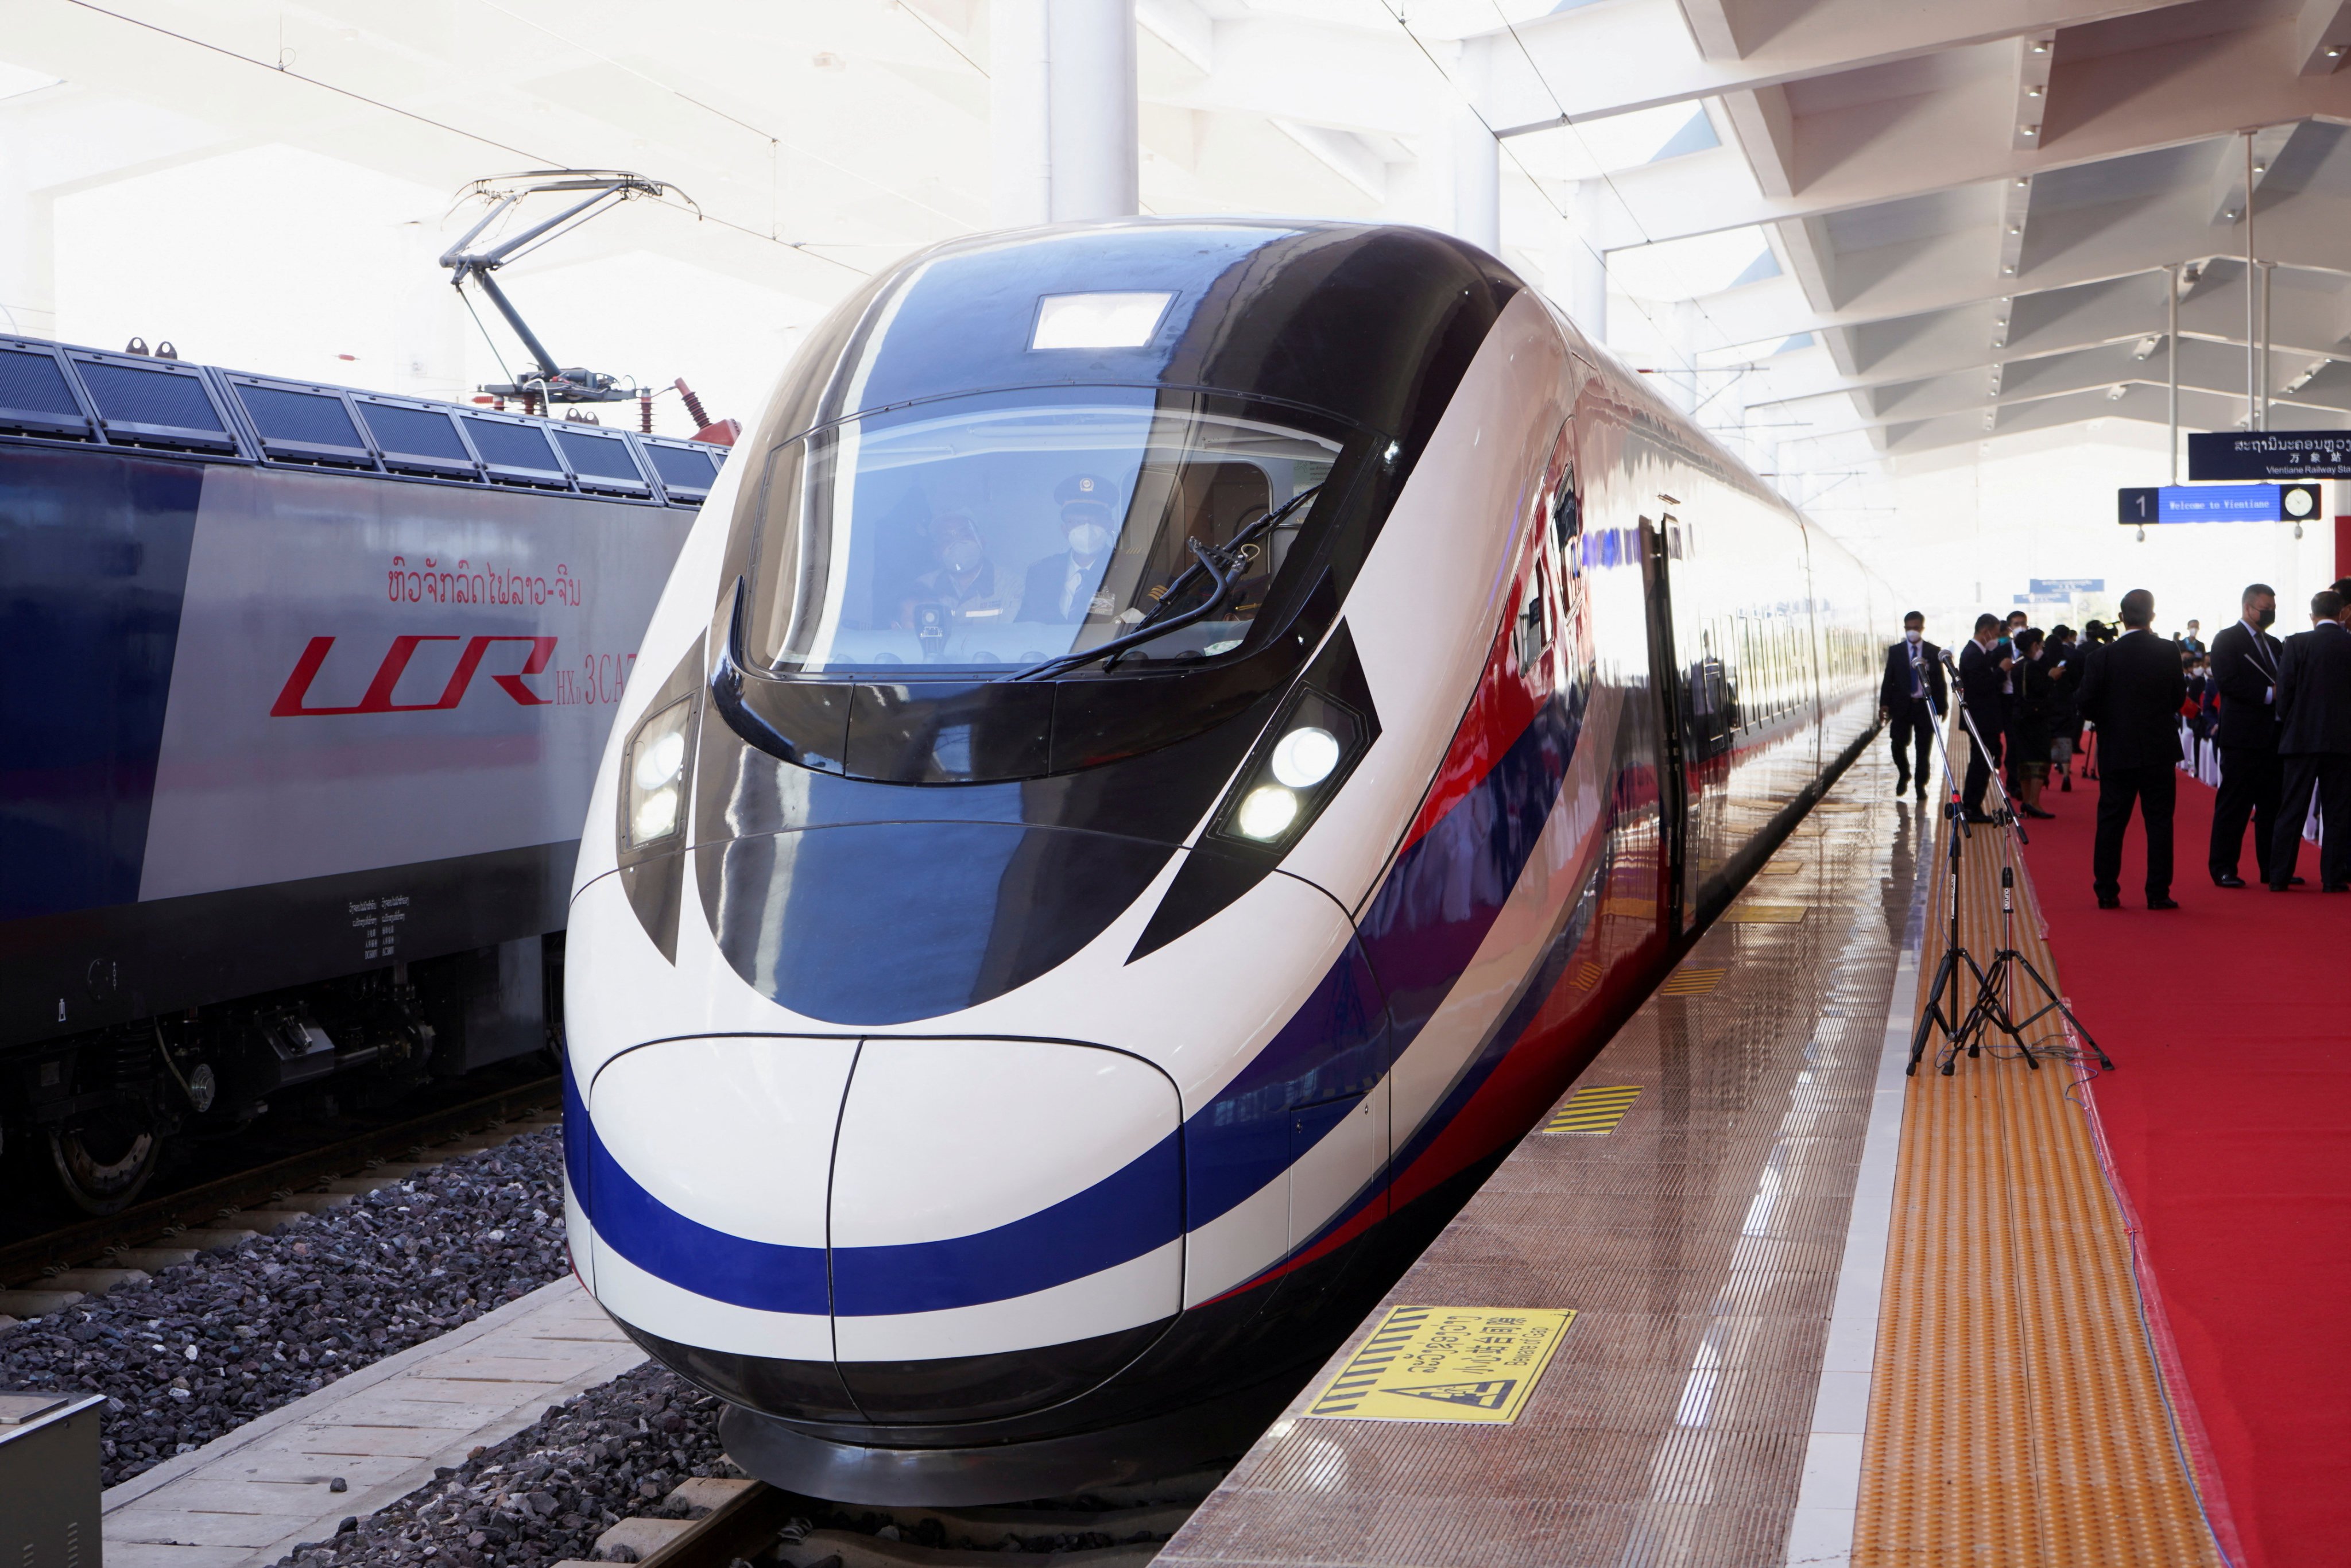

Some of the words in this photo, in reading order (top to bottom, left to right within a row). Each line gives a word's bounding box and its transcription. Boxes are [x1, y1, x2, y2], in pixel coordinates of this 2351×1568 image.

[2266, 466, 2304, 474] Vientiane
[2304, 464, 2337, 475] Railway
[2136, 495, 2145, 517] 1
[2170, 501, 2205, 510] Welcome
[2210, 501, 2221, 510] to
[2224, 499, 2269, 509] Vientiane
[1503, 1345, 1539, 1366] Beware
[1522, 1326, 1555, 1338] Gap
